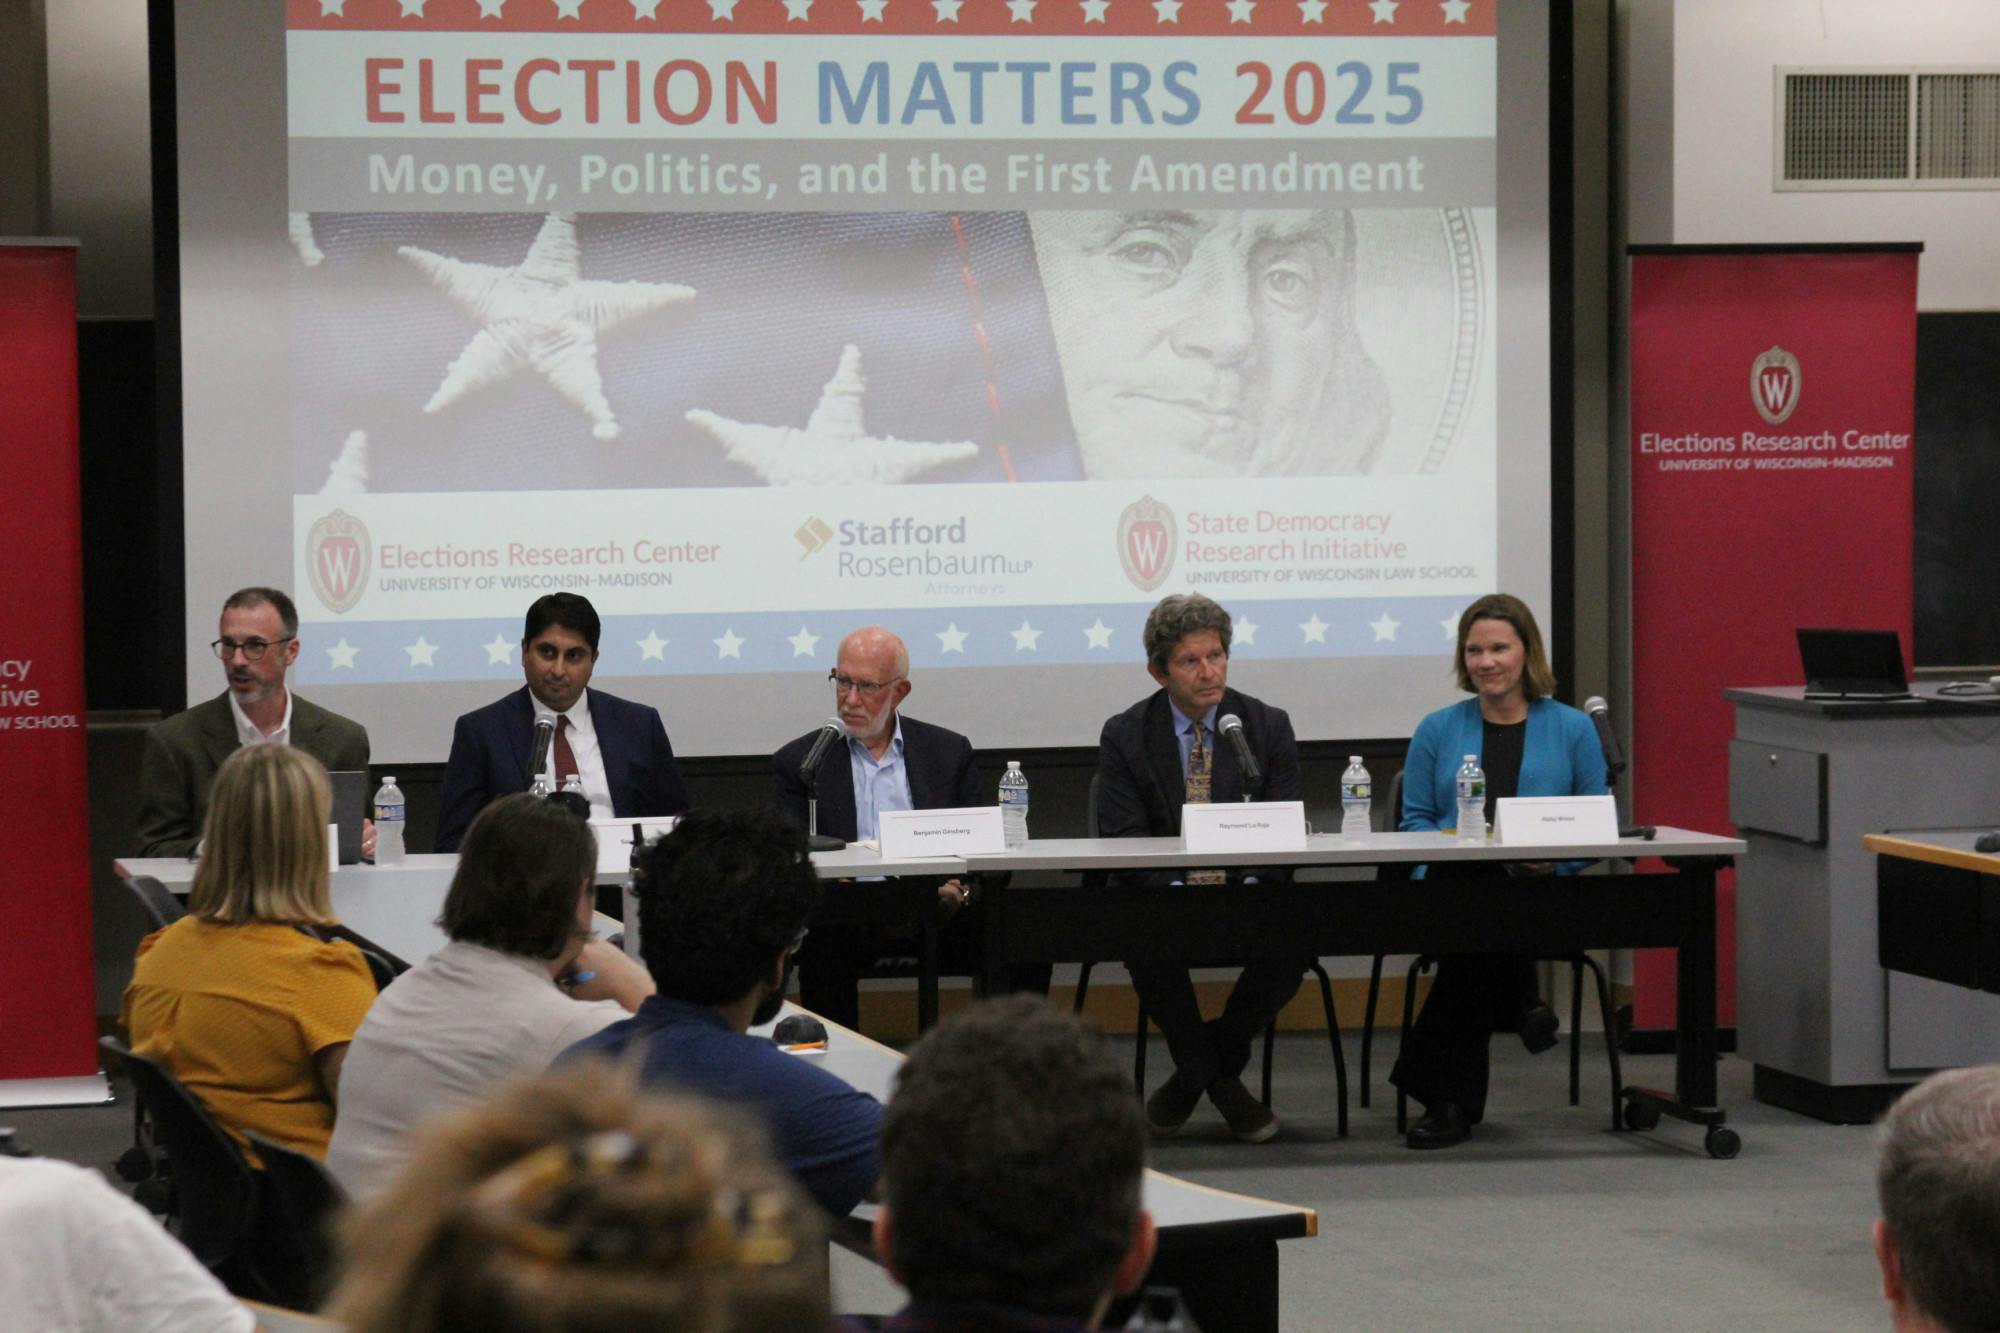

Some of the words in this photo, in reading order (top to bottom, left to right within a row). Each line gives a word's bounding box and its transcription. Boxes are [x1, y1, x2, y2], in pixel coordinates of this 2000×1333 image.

[365, 57, 778, 125] ELECTION
[818, 60, 1202, 126] MATTERS
[1234, 60, 1425, 126] 2025
[368, 153, 559, 202] Money,
[580, 152, 779, 201] Politics,
[799, 152, 888, 194] and
[907, 154, 987, 193] the
[1008, 152, 1112, 193] First
[1130, 151, 1425, 194] Amendment
[1762, 372, 1790, 409] W
[1640, 432, 1735, 453] Elections
[1741, 430, 1836, 451] Research
[1842, 430, 1911, 450] Center
[1659, 458, 1732, 471] UNIVERSITY
[1734, 458, 1752, 470] OF
[839, 516, 966, 546] Stafford
[1186, 512, 1249, 534] State
[1256, 510, 1392, 537] Democracy
[380, 543, 499, 570] Elections
[508, 541, 624, 567] Research
[633, 539, 721, 565] Center
[838, 549, 1006, 578] Rosenbaum
[1008, 560, 1033, 574] LLP
[1132, 530, 1162, 572] W
[1186, 539, 1295, 563] Research
[1302, 537, 1408, 560] Initiative
[322, 546, 357, 593] W
[1186, 570, 1270, 585] UNIVERSITY
[1274, 569, 1293, 583] OF
[1297, 567, 1380, 582] WISCONSIN
[1384, 567, 1416, 581] LAW
[1419, 566, 1478, 580] SCHOOL
[379, 576, 472, 592] UNIVERSITY
[475, 576, 498, 590] OF
[0, 659, 33, 682] cy
[15, 714, 80, 730] SCHOOL
